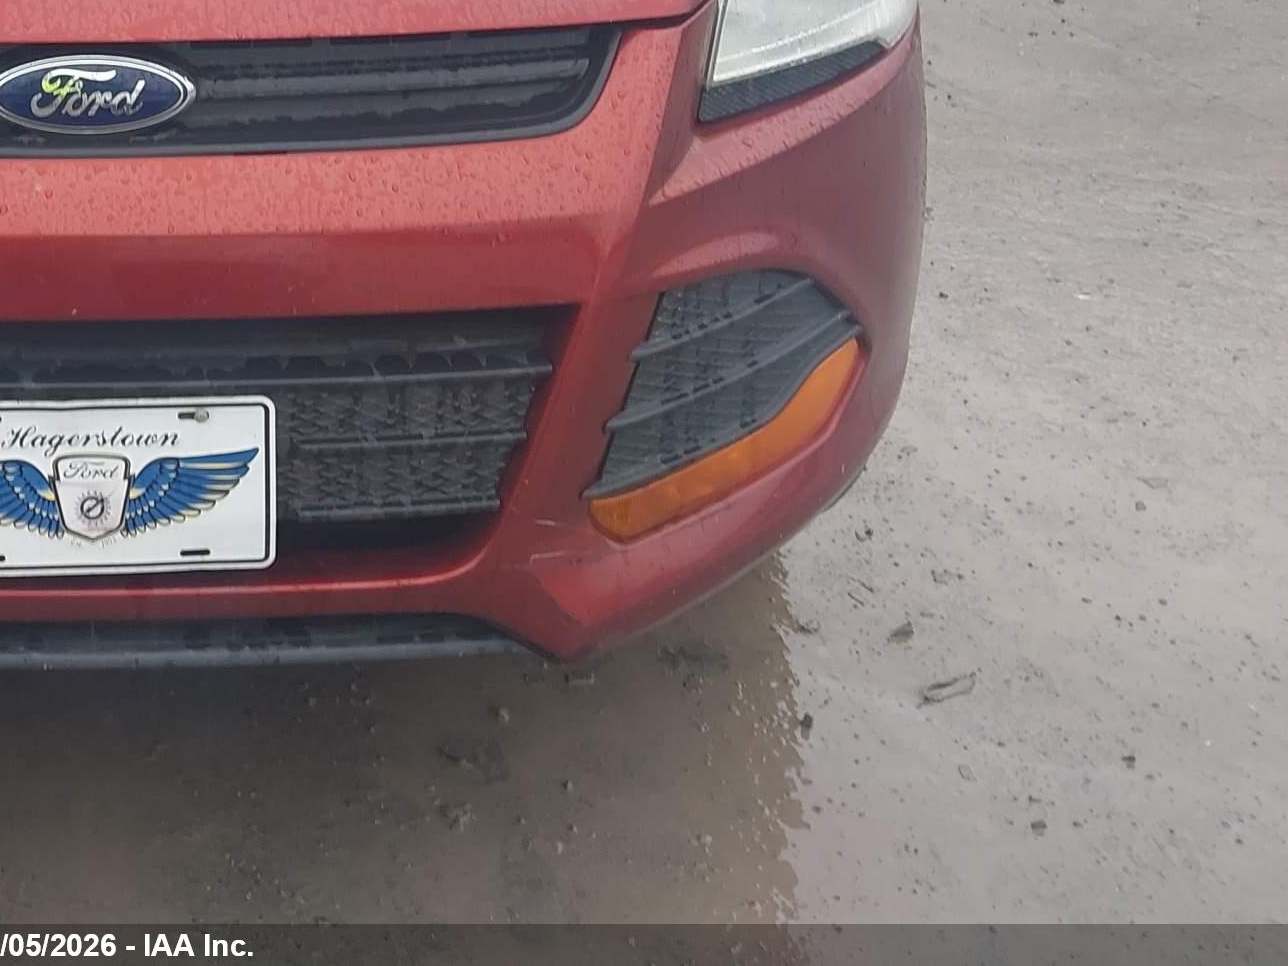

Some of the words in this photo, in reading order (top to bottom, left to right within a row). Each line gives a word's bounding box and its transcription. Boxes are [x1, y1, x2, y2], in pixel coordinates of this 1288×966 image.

[30, 68, 146, 118] Ford
[1, 426, 179, 456] Hagerstown
[63, 461, 119, 480] Ford
